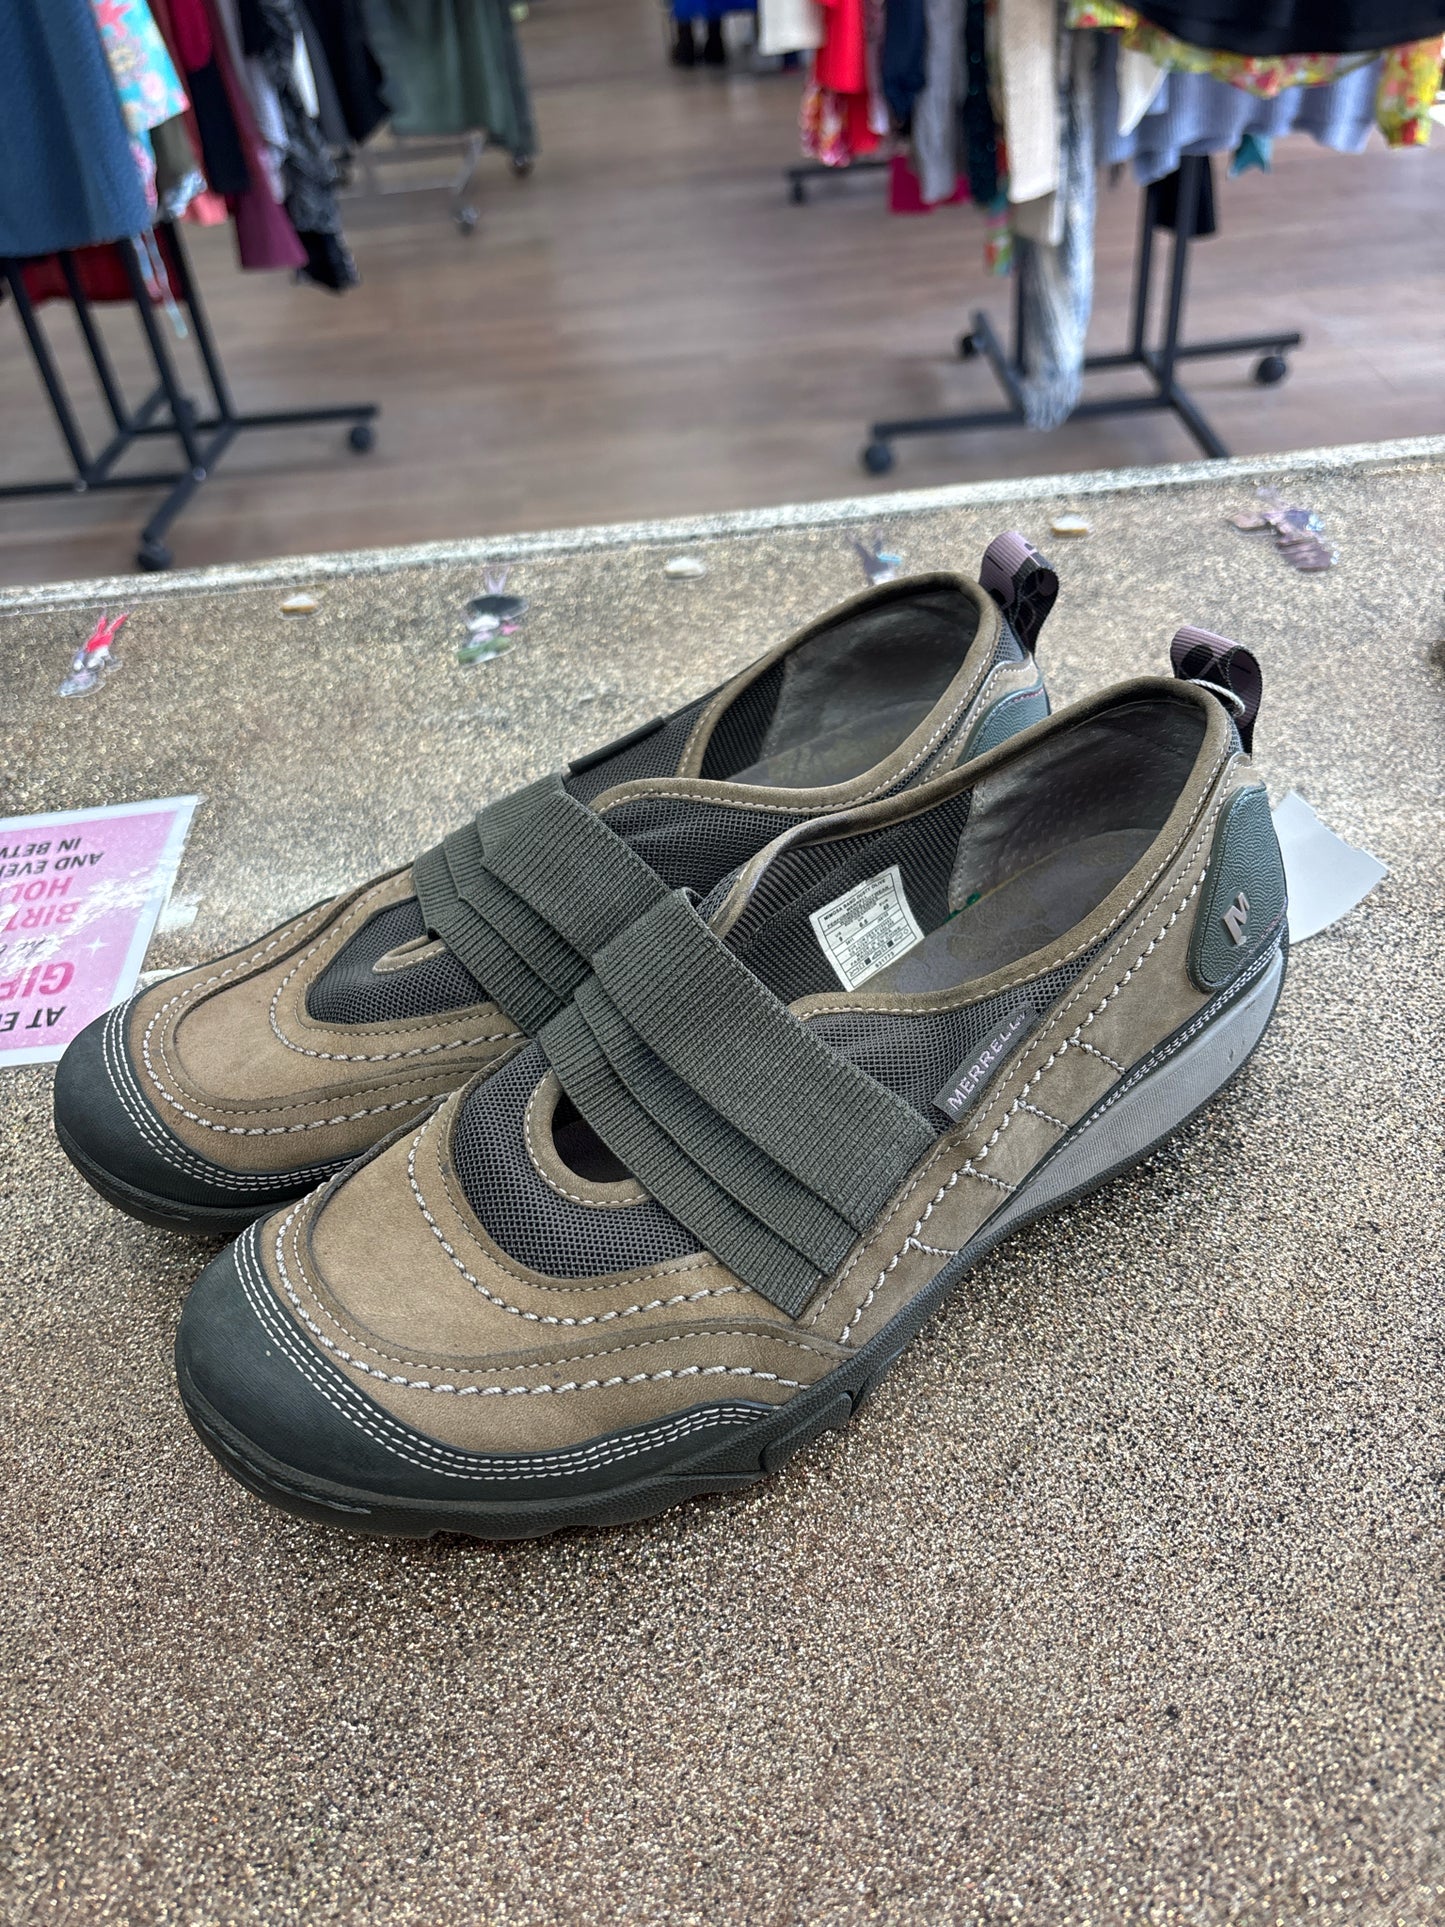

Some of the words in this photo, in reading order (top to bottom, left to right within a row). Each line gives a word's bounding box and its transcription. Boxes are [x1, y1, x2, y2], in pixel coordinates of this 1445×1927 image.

[56, 838, 82, 853] IN
[54, 852, 104, 871] AND
[0, 1011, 20, 1032] E
[25, 1006, 67, 1029] AT
[946, 1017, 1022, 1111] MERRELL
